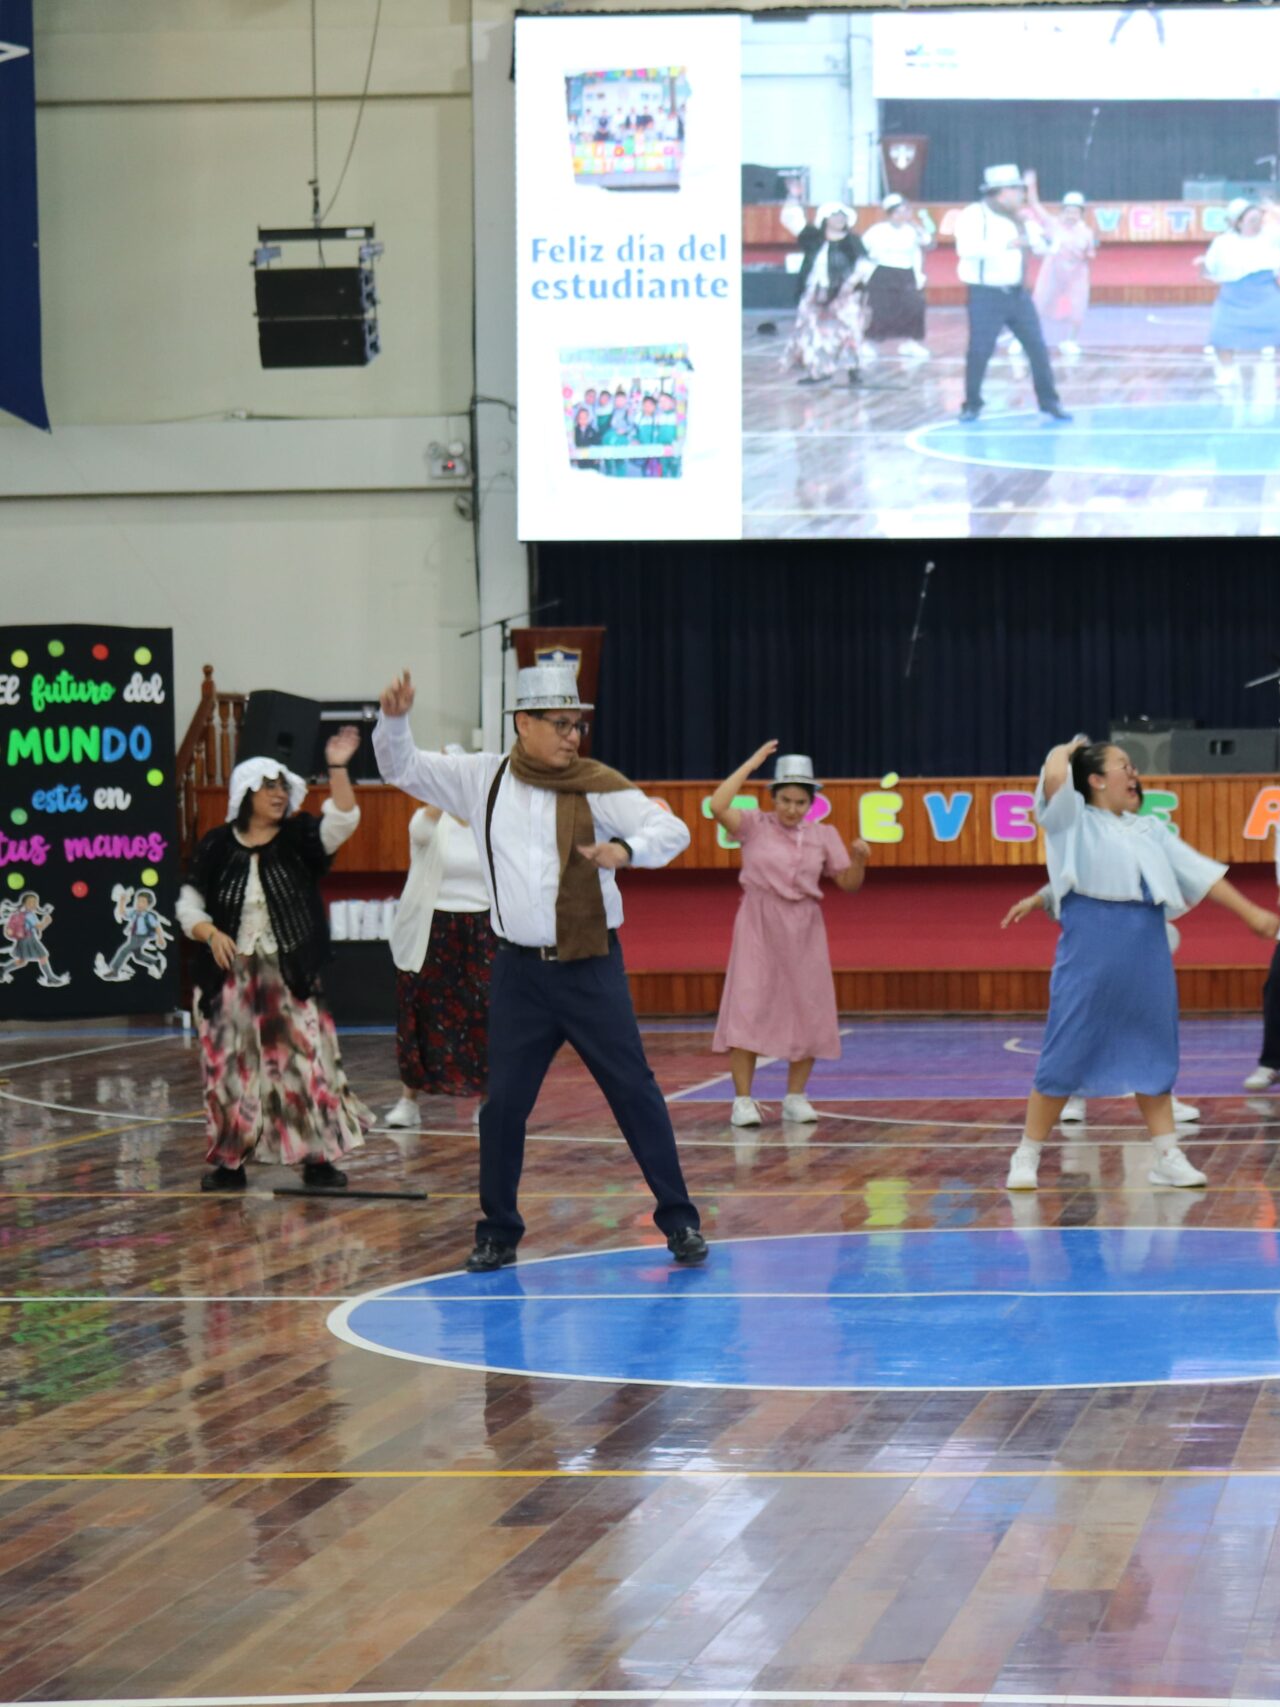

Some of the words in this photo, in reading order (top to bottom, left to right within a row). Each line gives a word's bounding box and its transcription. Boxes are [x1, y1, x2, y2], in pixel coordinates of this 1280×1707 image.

[532, 235, 604, 263] Feliz
[616, 233, 665, 262] día
[677, 233, 727, 262] del
[530, 268, 729, 300] estudiante
[31, 669, 116, 713] futuro
[123, 671, 166, 705] del
[6, 724, 153, 766] MUNDO
[31, 783, 89, 813] está
[93, 786, 132, 811] en
[63, 831, 168, 863] manos
